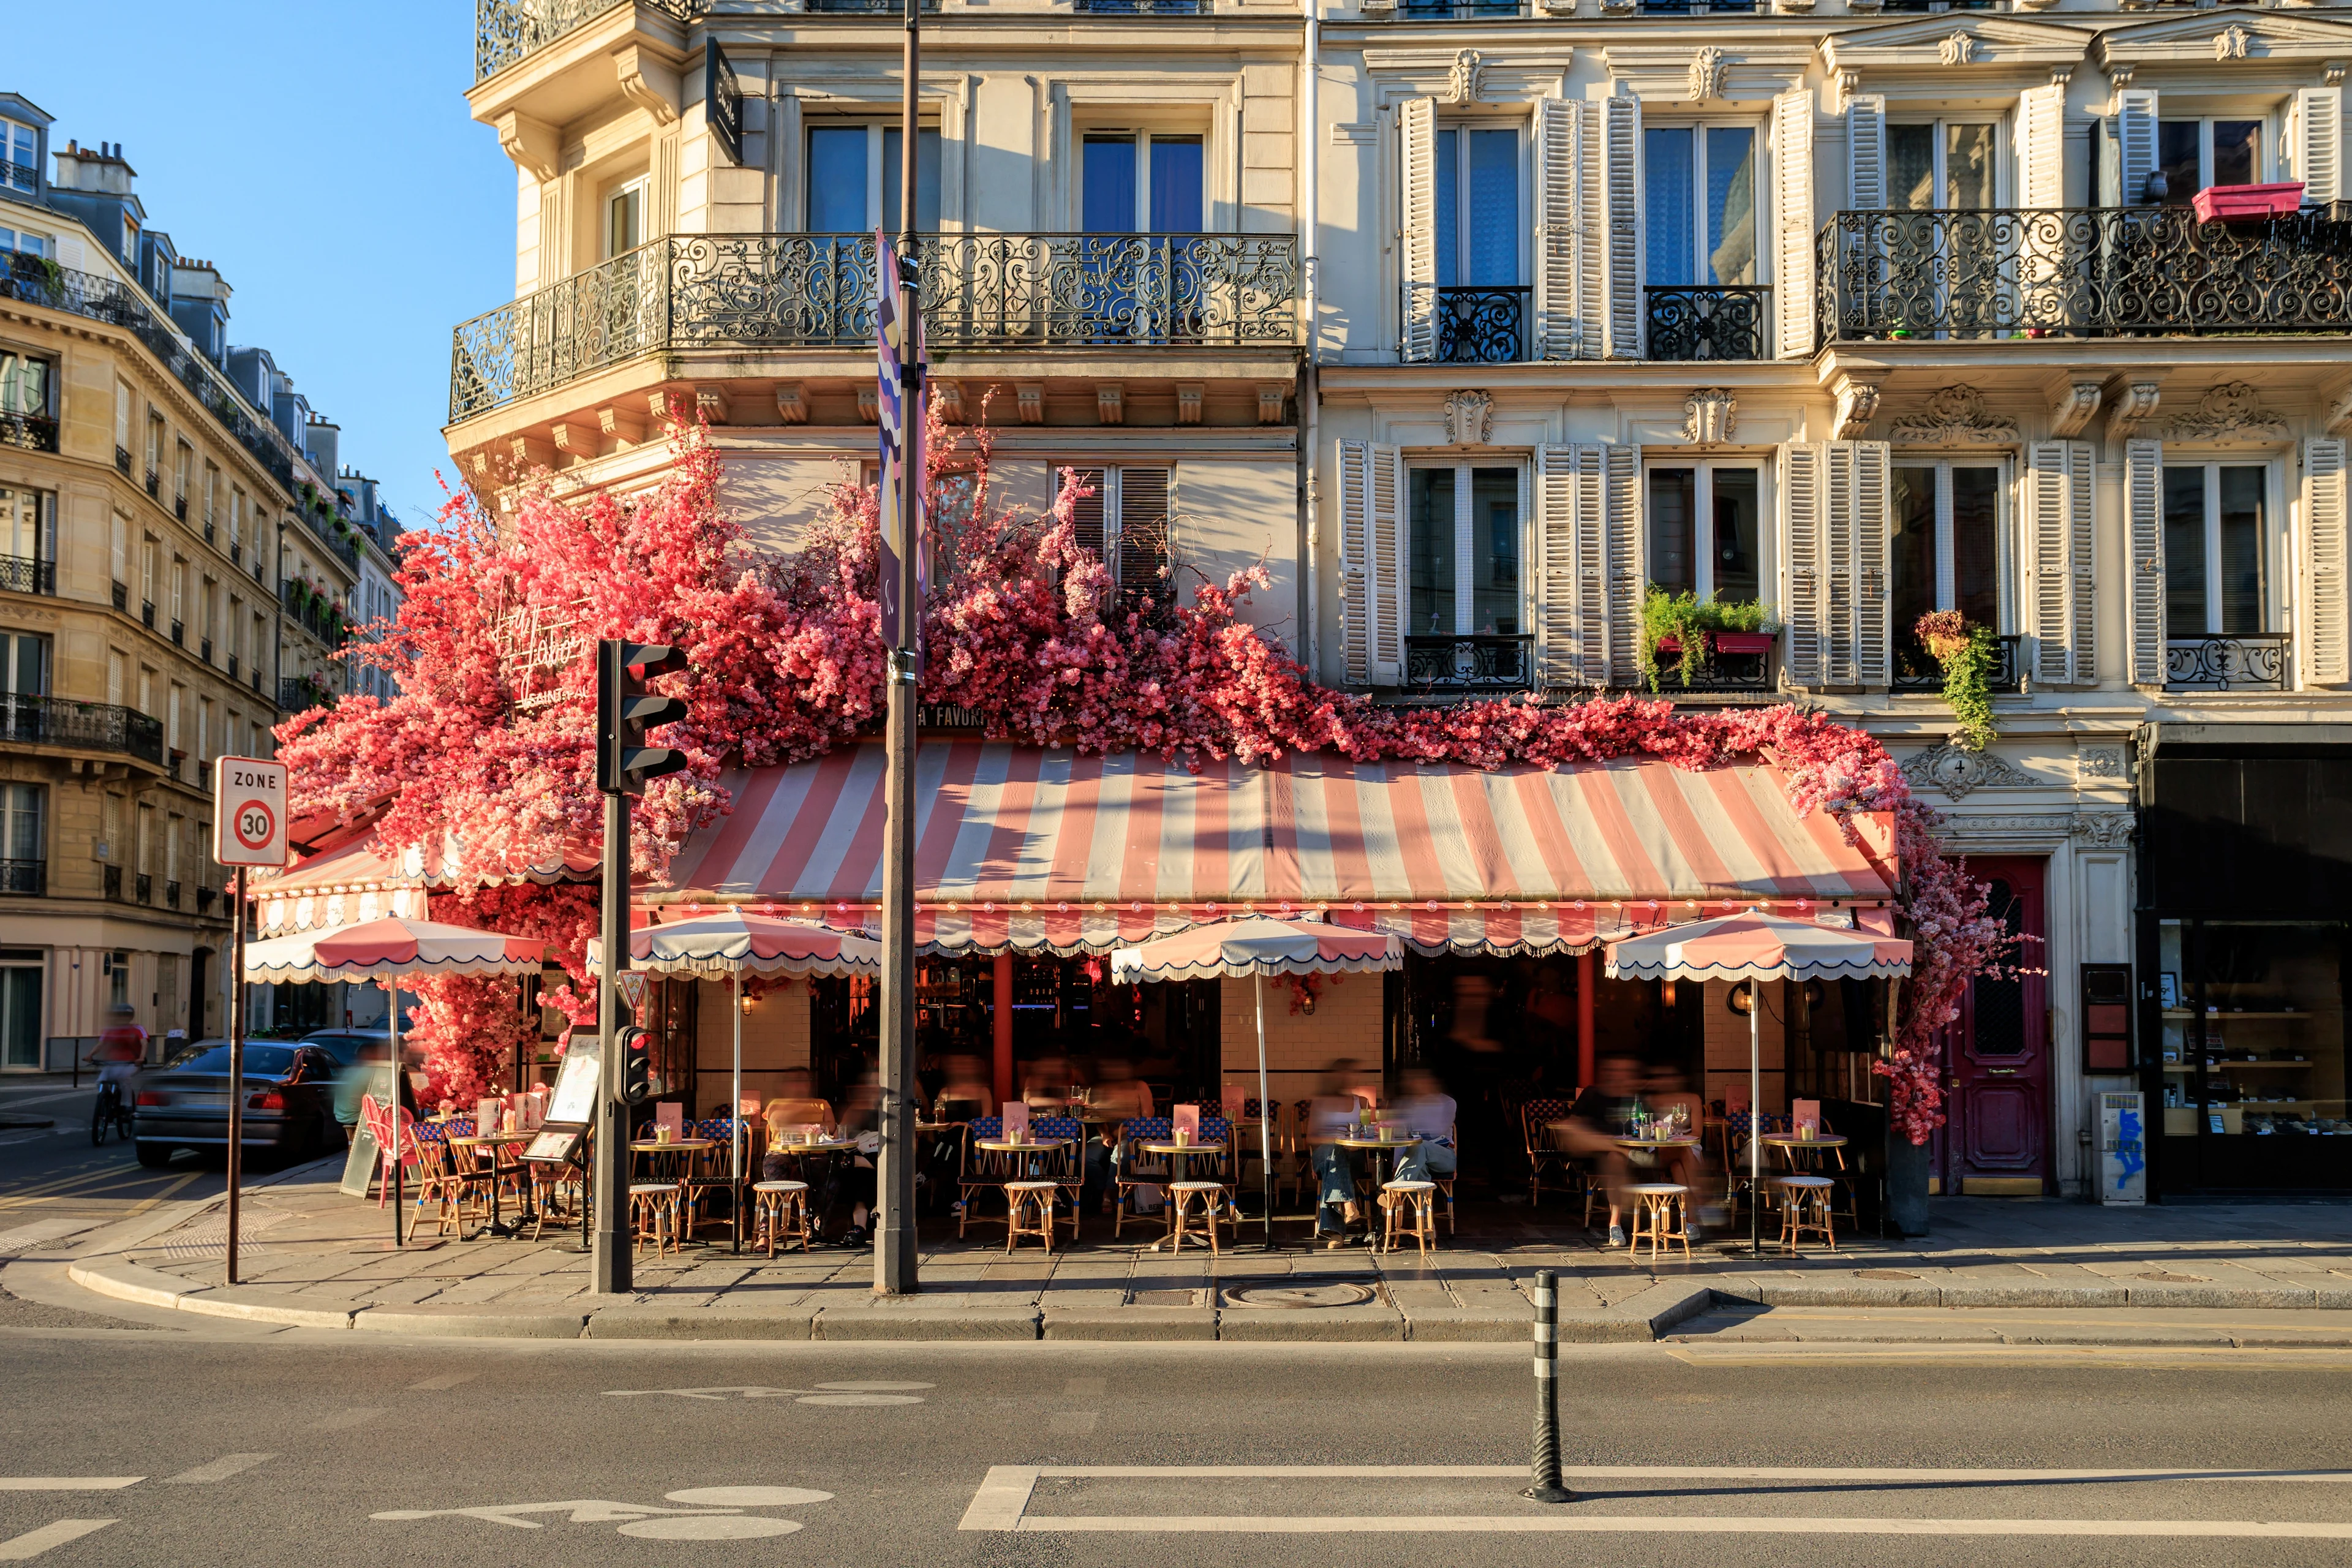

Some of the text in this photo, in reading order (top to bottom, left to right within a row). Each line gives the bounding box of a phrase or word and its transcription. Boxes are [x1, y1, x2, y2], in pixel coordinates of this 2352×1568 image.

[719, 59, 735, 96] HOTEL
[717, 82, 735, 126] Emile
[937, 707, 990, 726] FAVORI
[1954, 760, 1966, 774] 4
[235, 772, 276, 789] ZONE
[243, 814, 267, 836] 30
[1614, 907, 1644, 933] La
